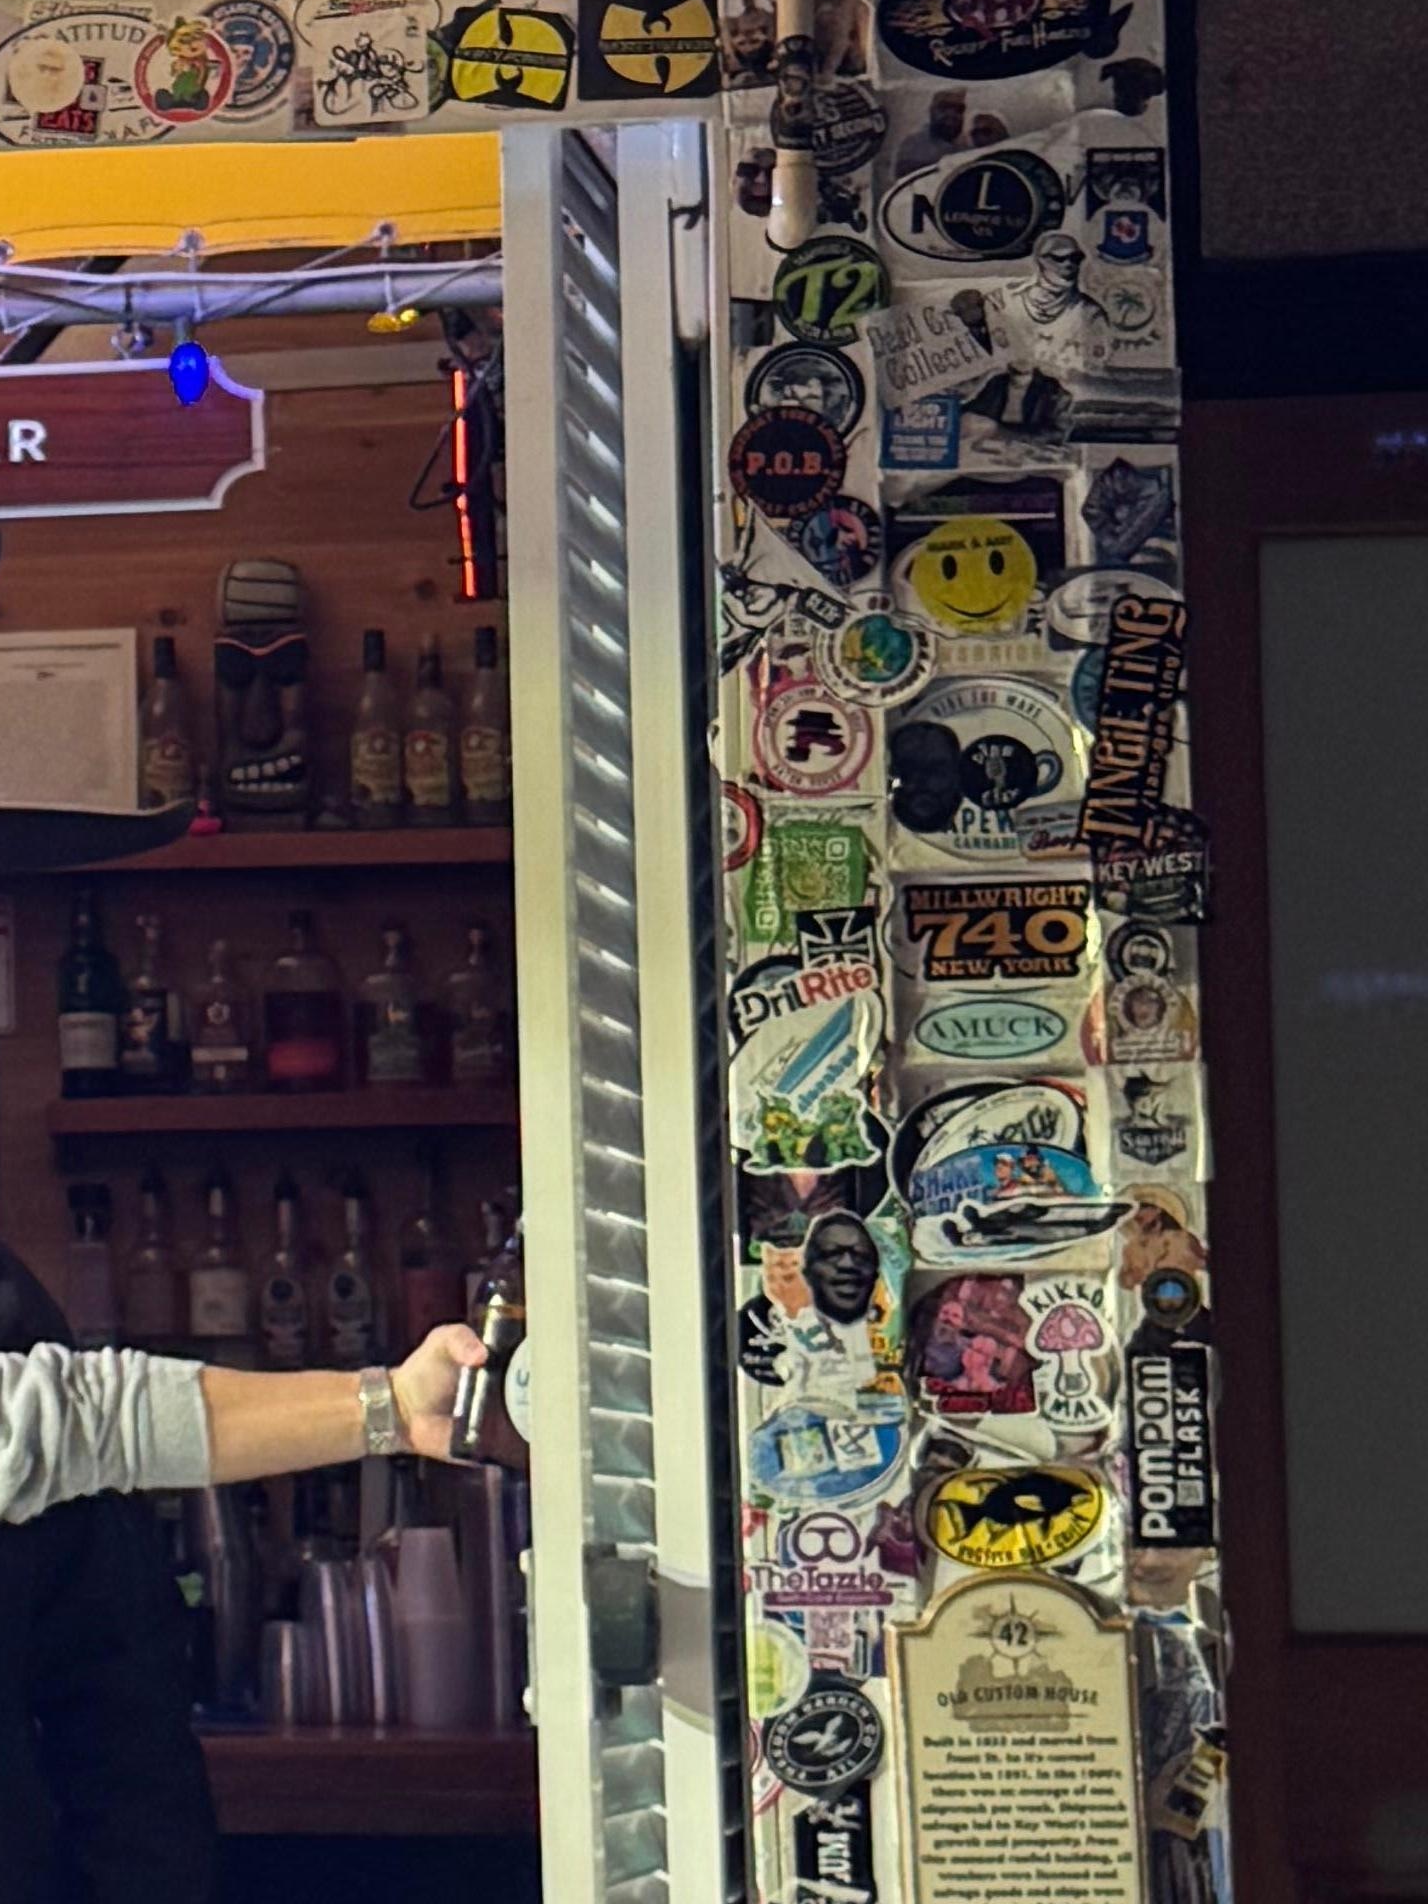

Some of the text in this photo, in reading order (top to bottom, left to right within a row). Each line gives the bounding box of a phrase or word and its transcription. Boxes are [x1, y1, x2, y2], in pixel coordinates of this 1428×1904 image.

[744, 450, 831, 476] P.O.B.
[1098, 850, 1206, 883] KEY WEST
[909, 885, 1088, 910] MILLWRIGHT
[911, 909, 1086, 957] 740
[929, 956, 1073, 977] NEW YORK
[738, 962, 876, 1030] DrilRite
[927, 1014, 1059, 1042] AMUCK
[1027, 1278, 1105, 1312] KIKKO
[1050, 1399, 1103, 1421] MAI
[1175, 1384, 1204, 1480] FLASK
[1134, 1356, 1177, 1540] POMPOM
[999, 1623, 1029, 1648] 42
[973, 1685, 1040, 1703] CUSTOM
[1045, 1685, 1099, 1707] HOUSE
